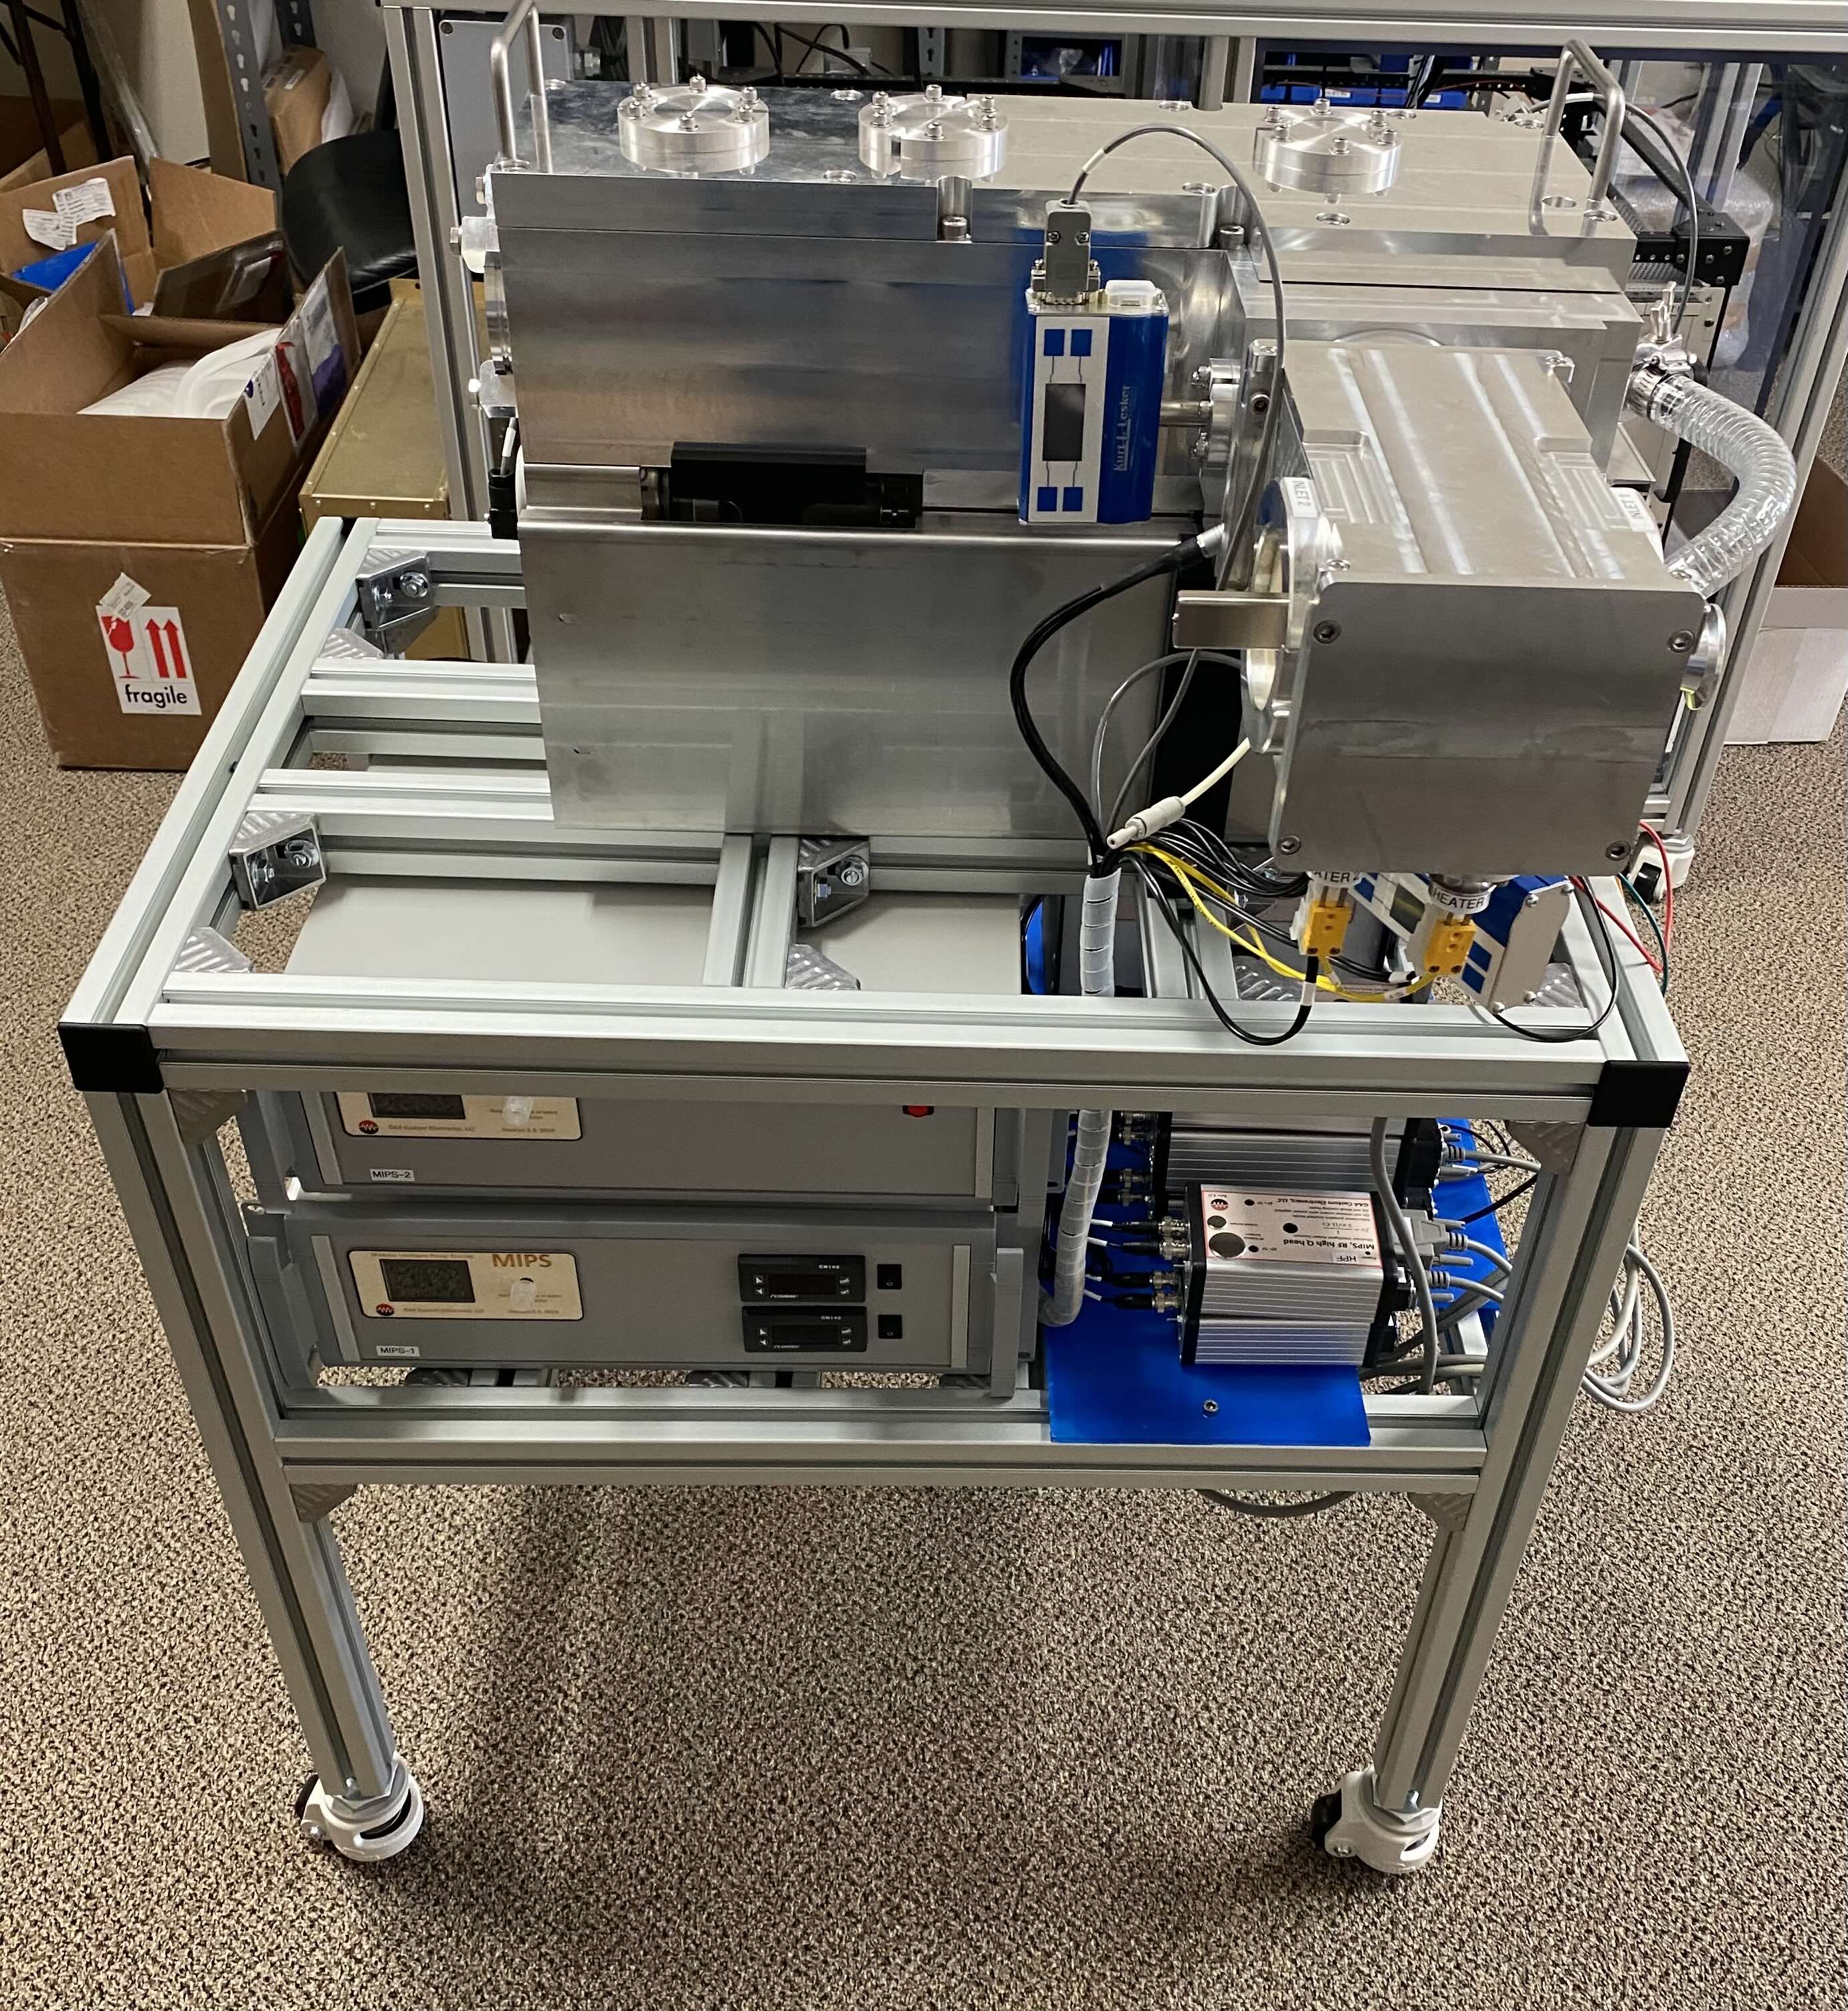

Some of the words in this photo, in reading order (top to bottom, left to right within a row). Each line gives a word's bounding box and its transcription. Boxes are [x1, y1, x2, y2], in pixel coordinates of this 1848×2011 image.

[1117, 385, 1130, 427] Lesker
[1113, 445, 1126, 471] Kurt
[125, 684, 187, 708] fragile
[1433, 888, 1485, 909] HEATER
[372, 1169, 411, 1179] MIPS-2
[1316, 1240, 1334, 1248] high
[1350, 1242, 1374, 1250] MIPS,
[492, 1253, 552, 1268] MIPS
[380, 1347, 415, 1355] MIPS-1
